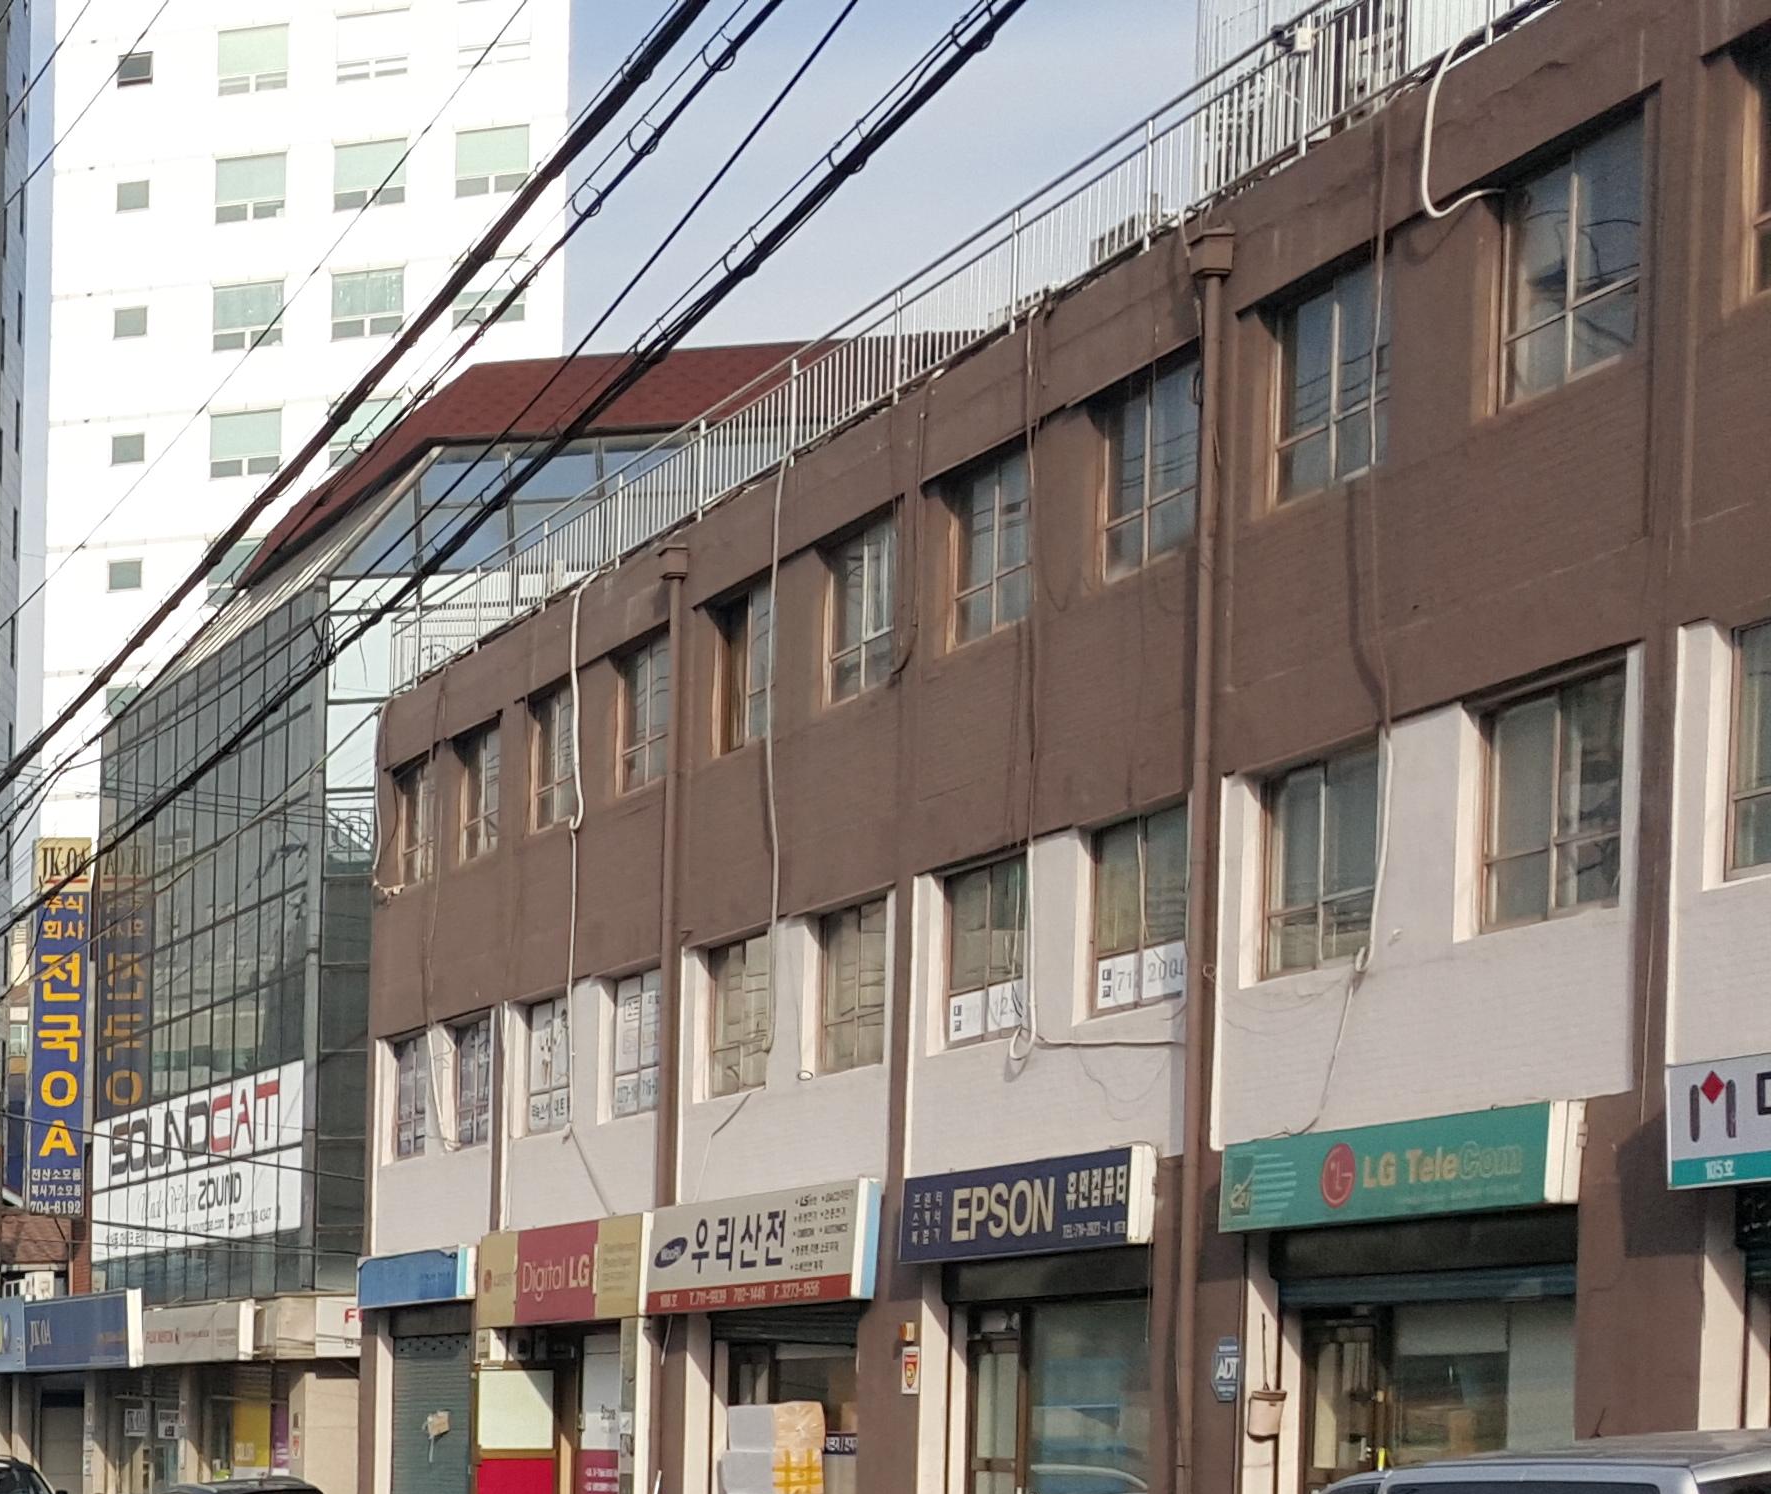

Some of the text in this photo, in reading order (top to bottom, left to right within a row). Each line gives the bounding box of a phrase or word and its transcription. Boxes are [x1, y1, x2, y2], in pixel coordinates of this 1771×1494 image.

[43, 894, 85, 916] 주식
[42, 919, 85, 941] 회사
[110, 1079, 280, 1177] SOUNDCAT
[1363, 1150, 1397, 1189] LG
[950, 1177, 1056, 1243] EPSON
[691, 1208, 787, 1274] 우리산전
[522, 1256, 566, 1303] Digital
[568, 1253, 591, 1289] LG
[1214, 1357, 1240, 1380] ADT
